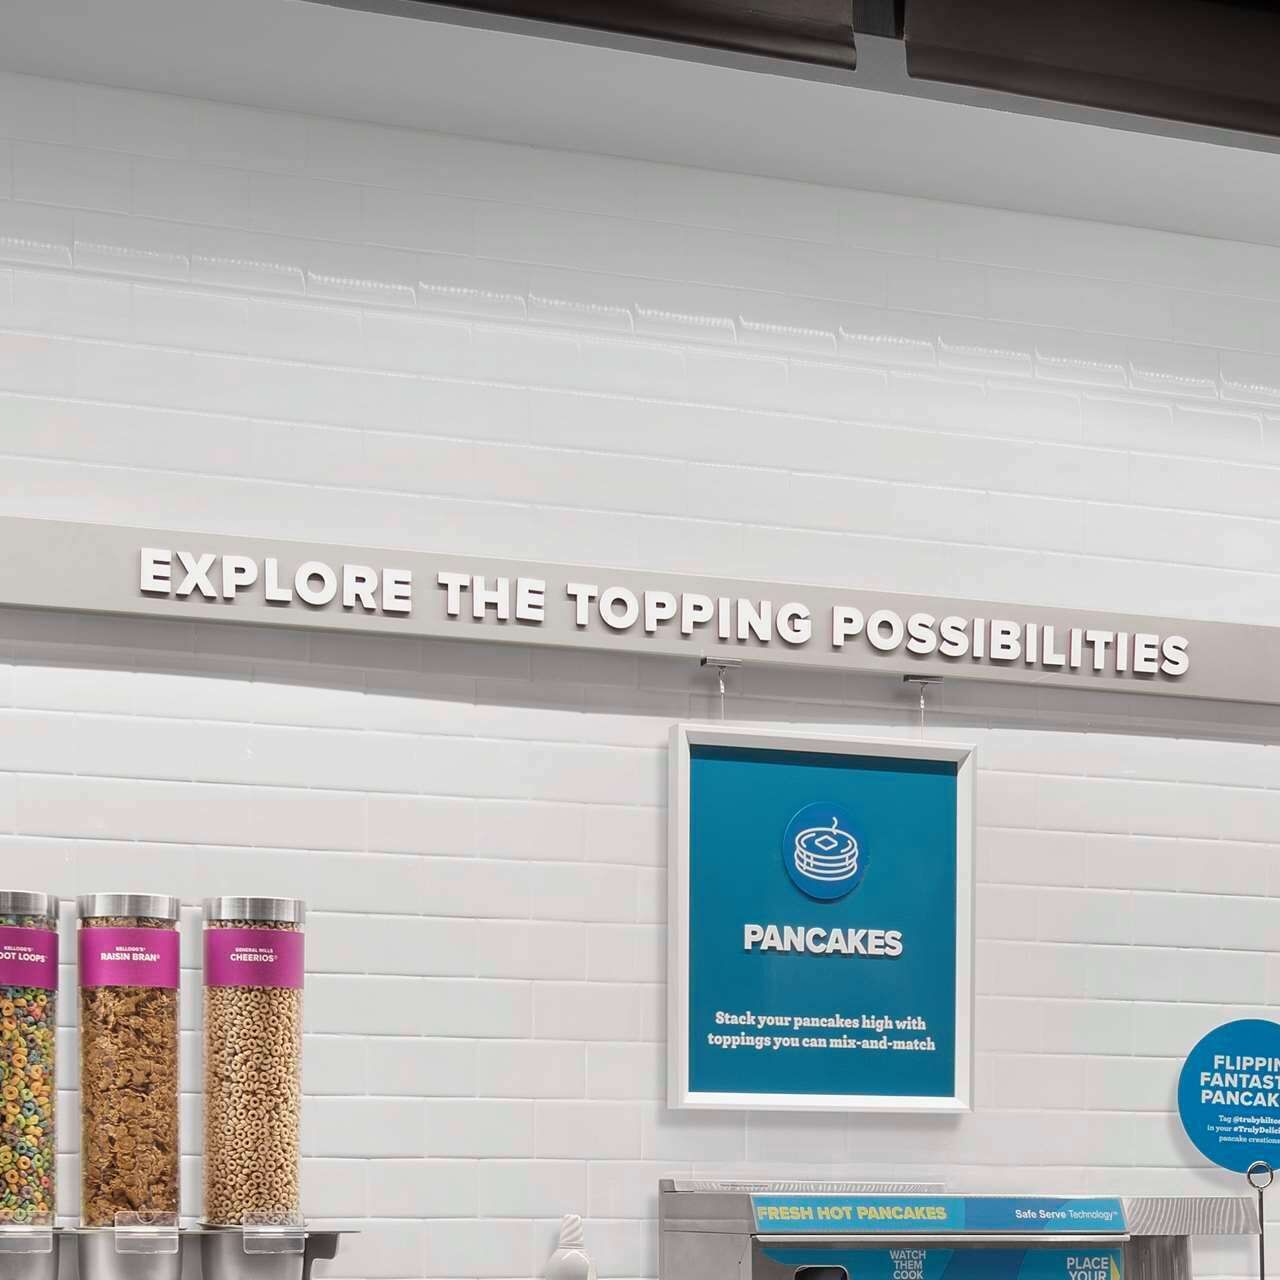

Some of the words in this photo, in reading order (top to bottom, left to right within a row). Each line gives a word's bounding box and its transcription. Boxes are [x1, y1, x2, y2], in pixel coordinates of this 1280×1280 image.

[139, 548, 412, 614] EXPLORE
[437, 571, 545, 622] THE
[567, 583, 811, 644] TOPPING
[832, 605, 1189, 675] POSSIBILITIES
[743, 923, 903, 957] PANCAKES
[100, 952, 131, 961] RAISIN
[715, 1011, 757, 1026] Stack
[757, 1015, 792, 1029] your
[793, 1014, 860, 1030] pancakes
[861, 1014, 894, 1032] high
[894, 1016, 926, 1031] with
[707, 1032, 771, 1049] toppings
[772, 1035, 800, 1050] you
[801, 1036, 827, 1048] can
[829, 1034, 936, 1051] mix-and-match
[1218, 1115, 1232, 1123] Tag
[757, 1206, 815, 1220] FRESH
[817, 1206, 853, 1220] HOT
[856, 1206, 947, 1221] PANCAKES
[1015, 1209, 1037, 1219] Safe
[1039, 1209, 1067, 1219] Serve
[1068, 1209, 1113, 1221] Technology
[889, 1249, 927, 1260] WATCH
[893, 1260, 923, 1270] THEM
[1066, 1256, 1109, 1270] PLACE
[892, 1269, 924, 1280] COOK
